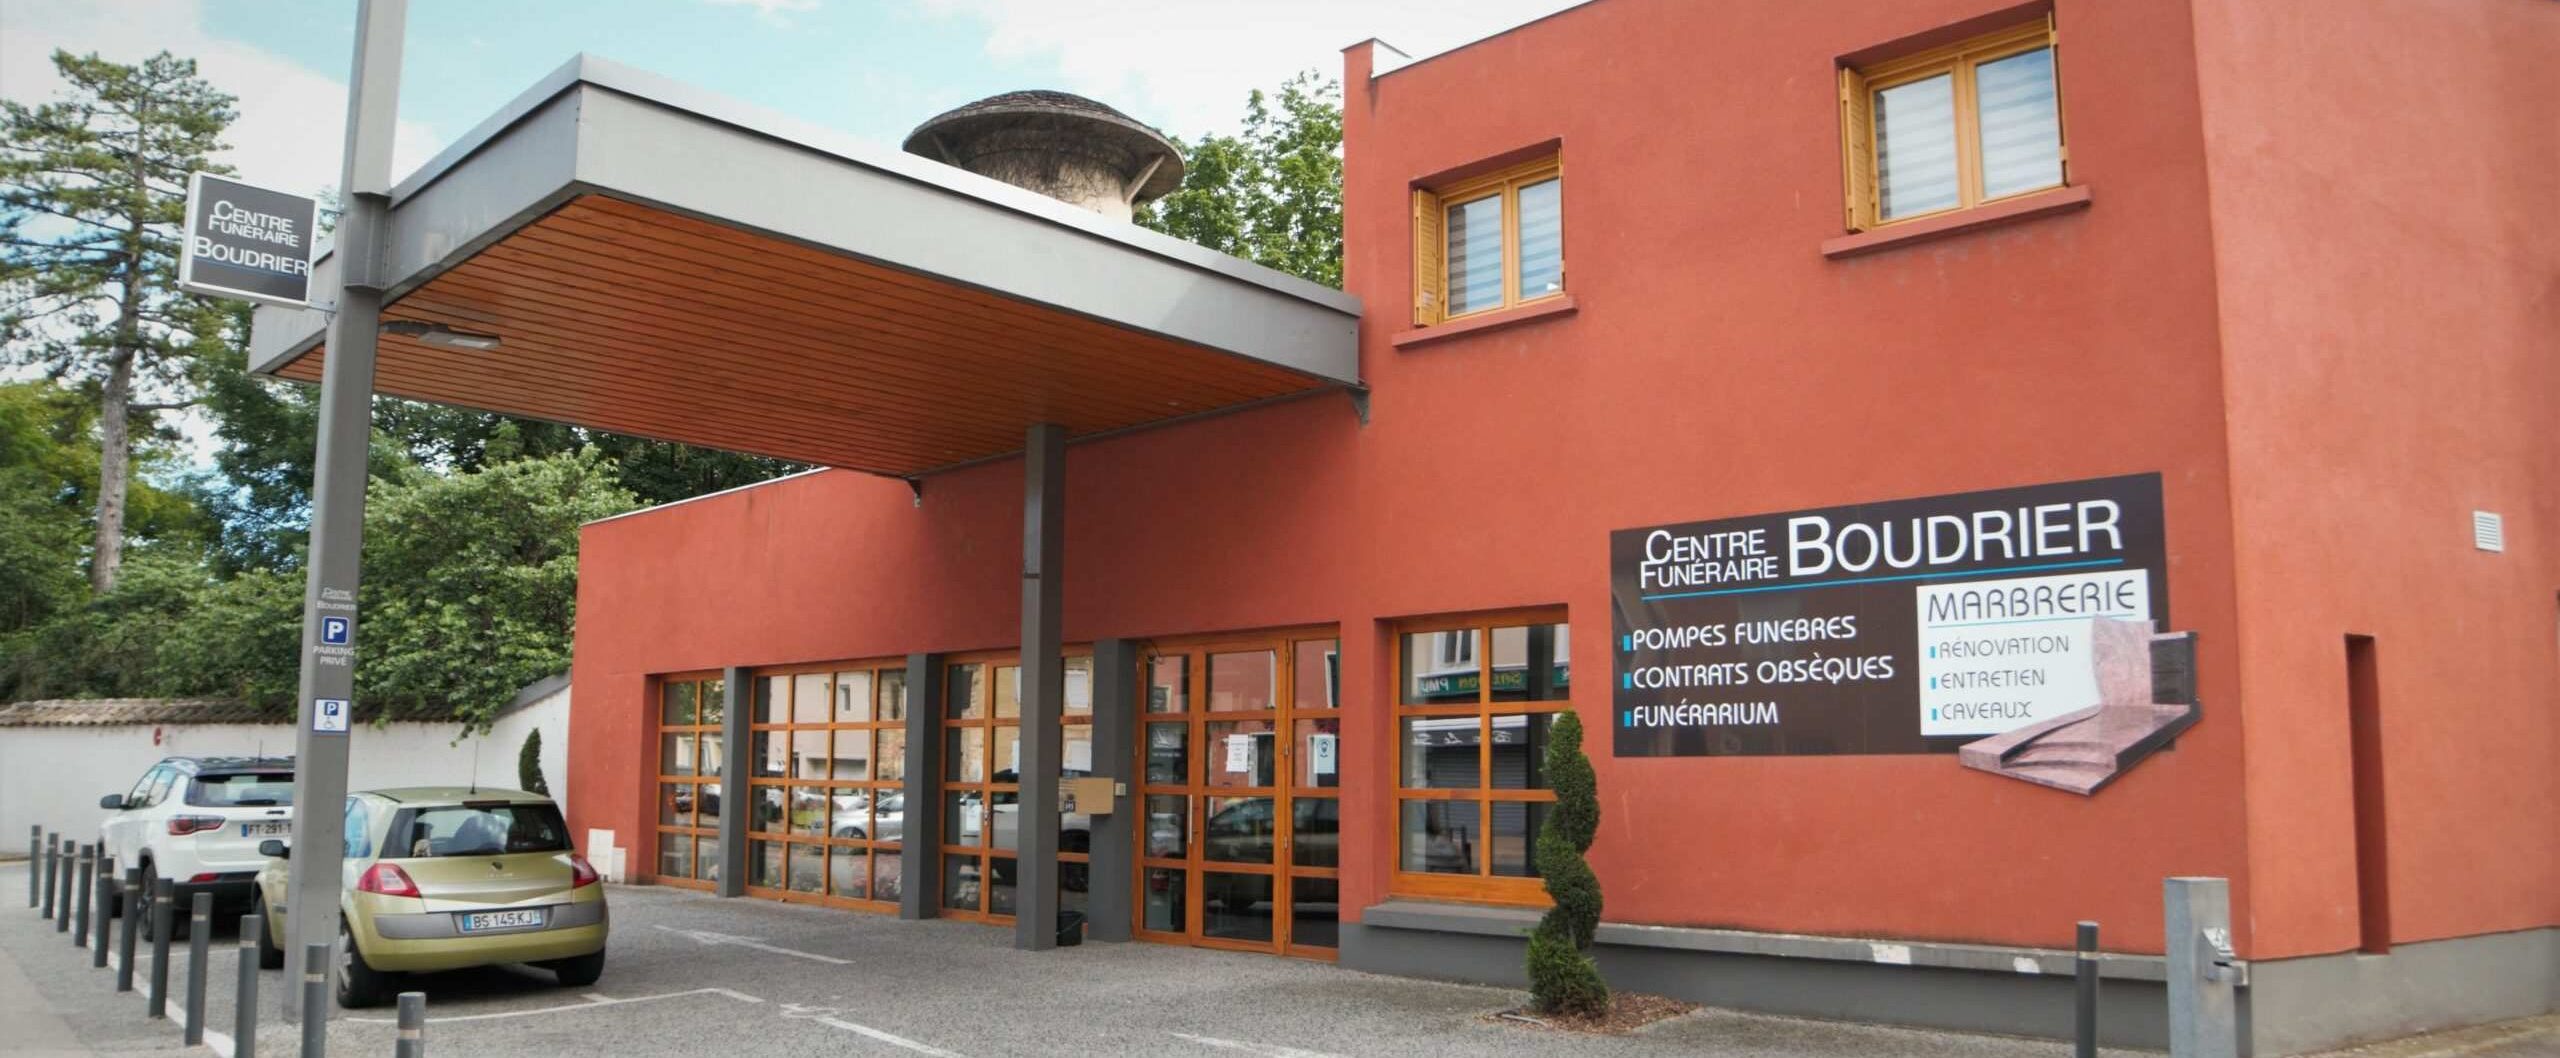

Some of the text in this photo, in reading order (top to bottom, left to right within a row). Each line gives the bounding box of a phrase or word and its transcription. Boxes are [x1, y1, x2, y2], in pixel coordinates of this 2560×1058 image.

[214, 200, 294, 234] CENTRE
[194, 236, 308, 277] BOUDRIER
[1645, 529, 1767, 564] CENTRE
[1788, 499, 2123, 577] BOUDRIER
[1640, 556, 1779, 589] FUNÉRAIRE
[1927, 579, 2135, 622] MARBRERIE
[327, 621, 345, 640] P
[1632, 615, 1857, 650] POMPES FUNEBRES
[1939, 635, 2070, 659] RÉNOVATION
[313, 645, 355, 657] PARKING
[1633, 652, 1895, 689] CONTRATS OBSÈQUES
[1941, 668, 2046, 690] ENTRETIEN
[1633, 698, 1779, 727] FUNÉRARIUM
[1941, 701, 2033, 720] CAVEAUX
